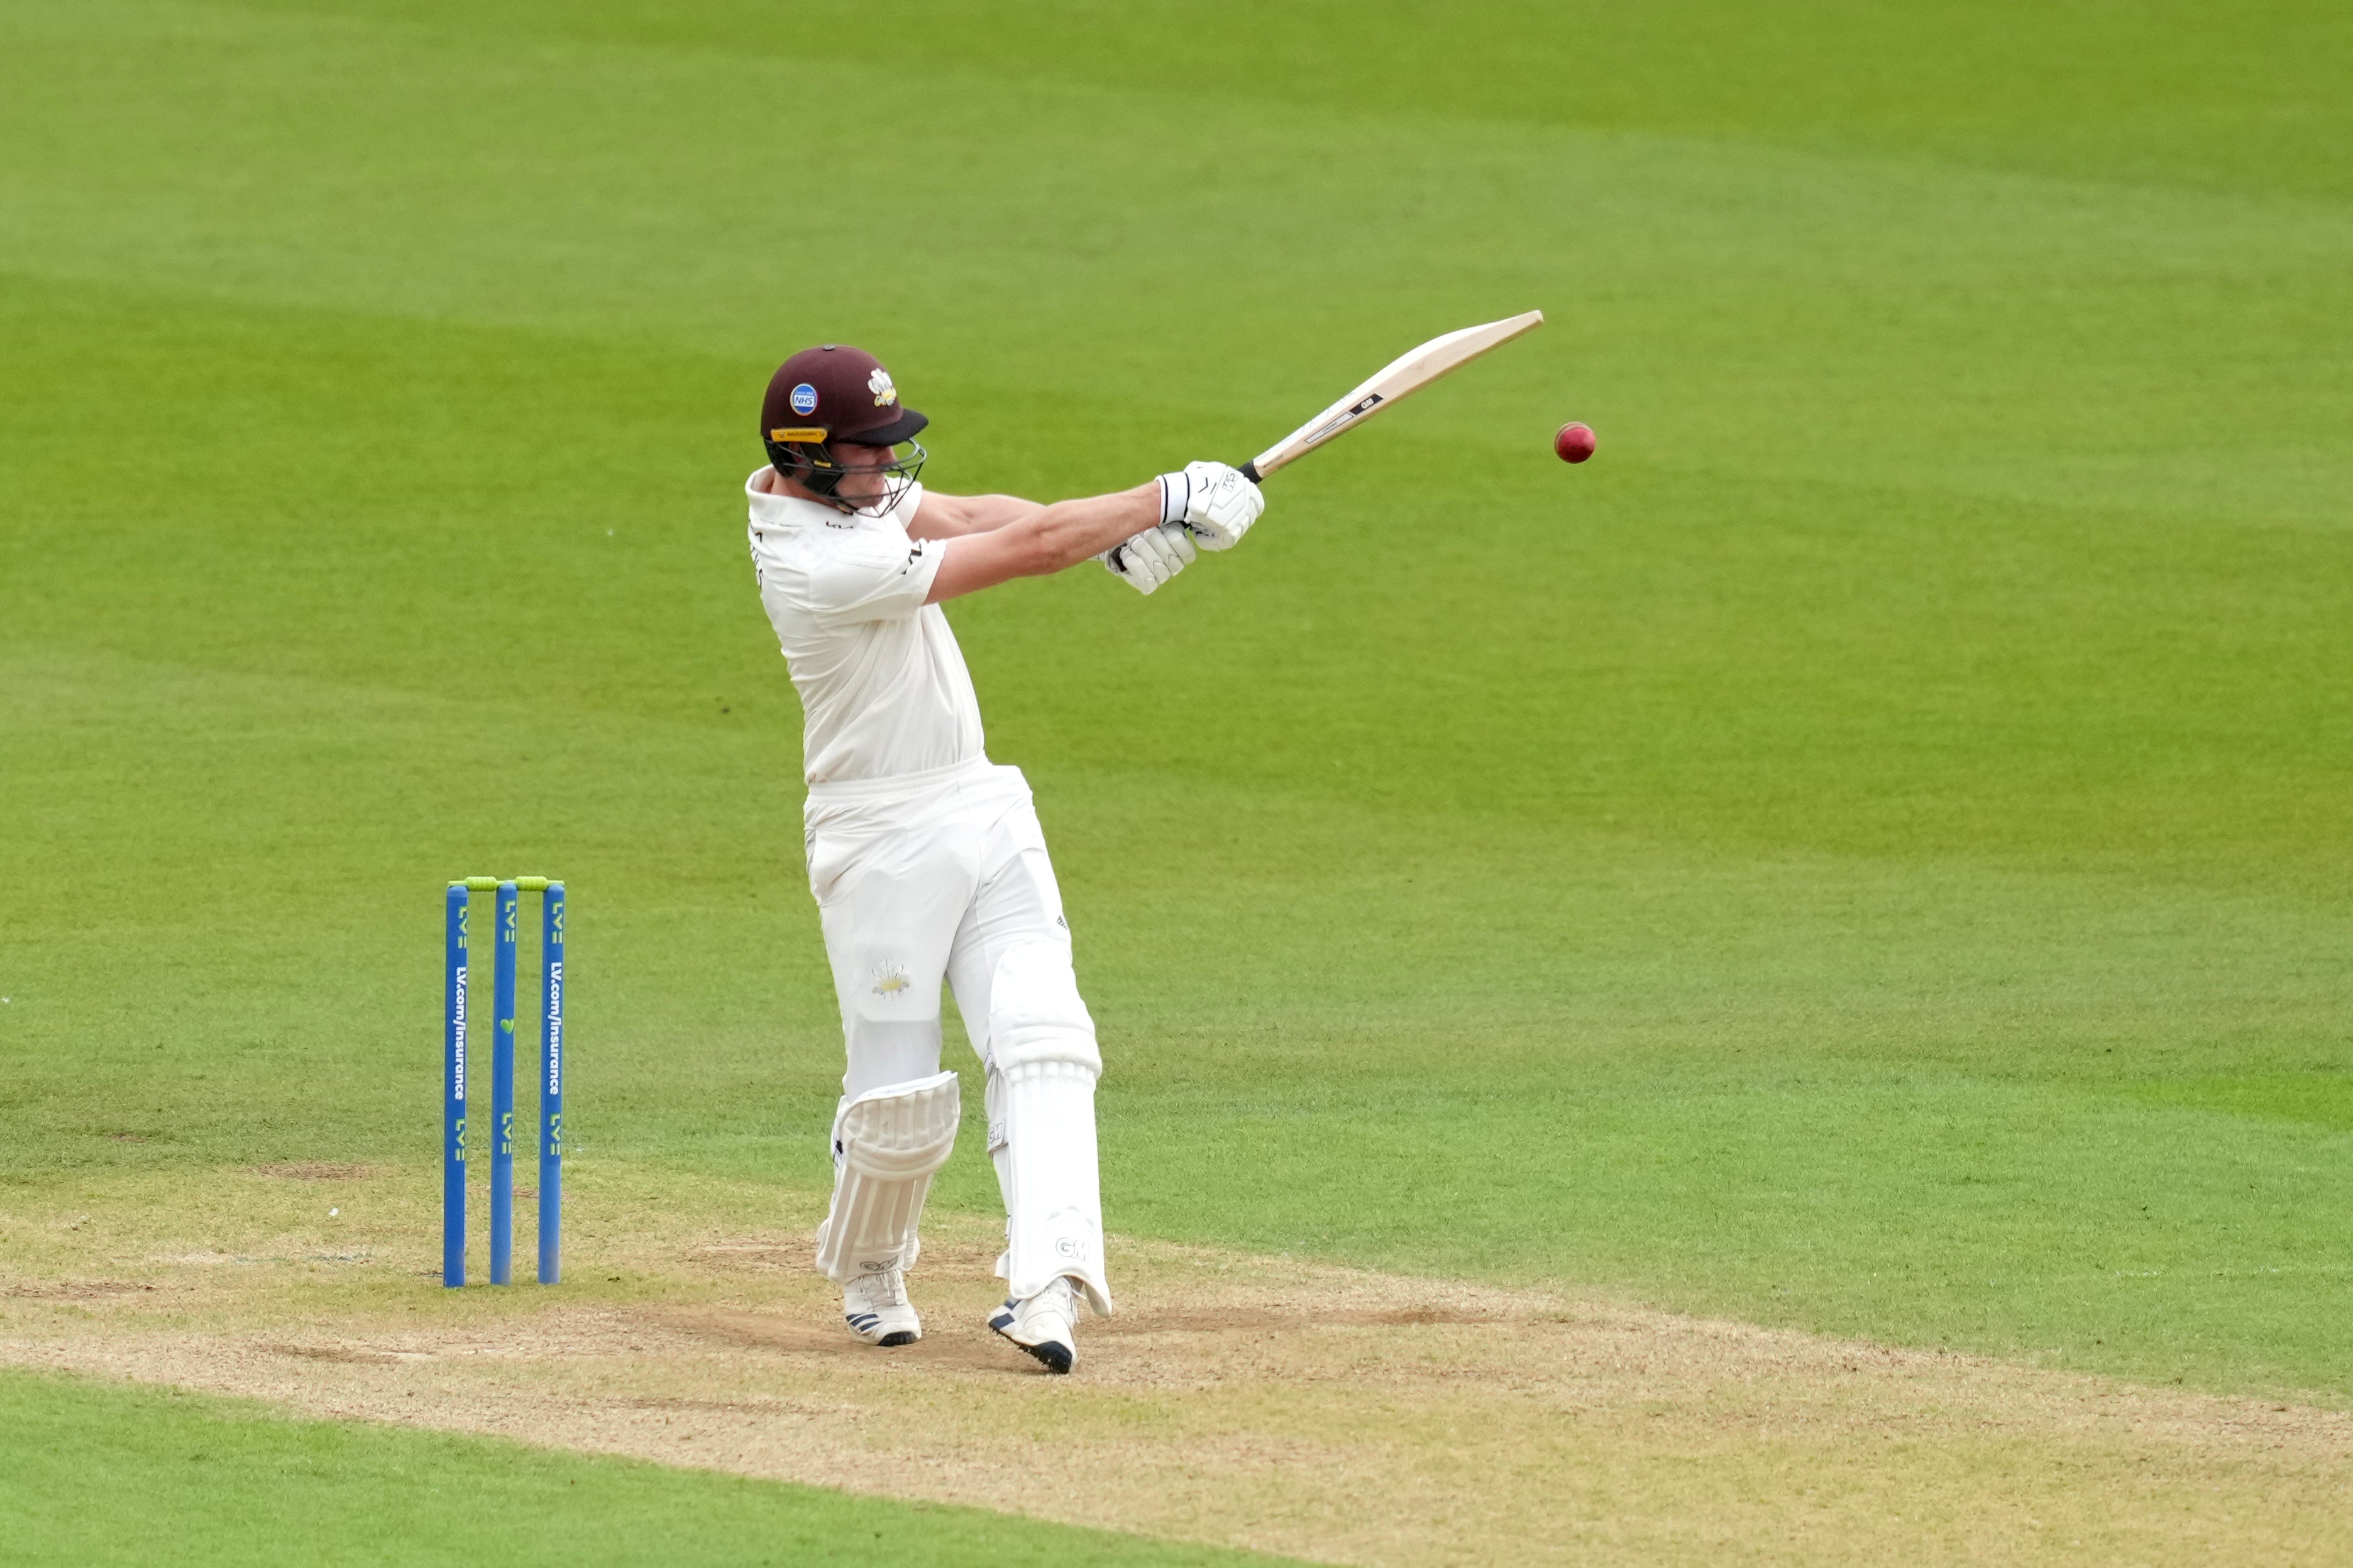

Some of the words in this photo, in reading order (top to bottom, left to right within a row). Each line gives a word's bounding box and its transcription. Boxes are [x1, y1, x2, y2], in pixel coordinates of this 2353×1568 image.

[795, 396, 813, 405] NHS
[1360, 398, 1375, 409] GM
[453, 967, 466, 1100] LV.com/insurance
[548, 962, 562, 1095] LV.com/insurance
